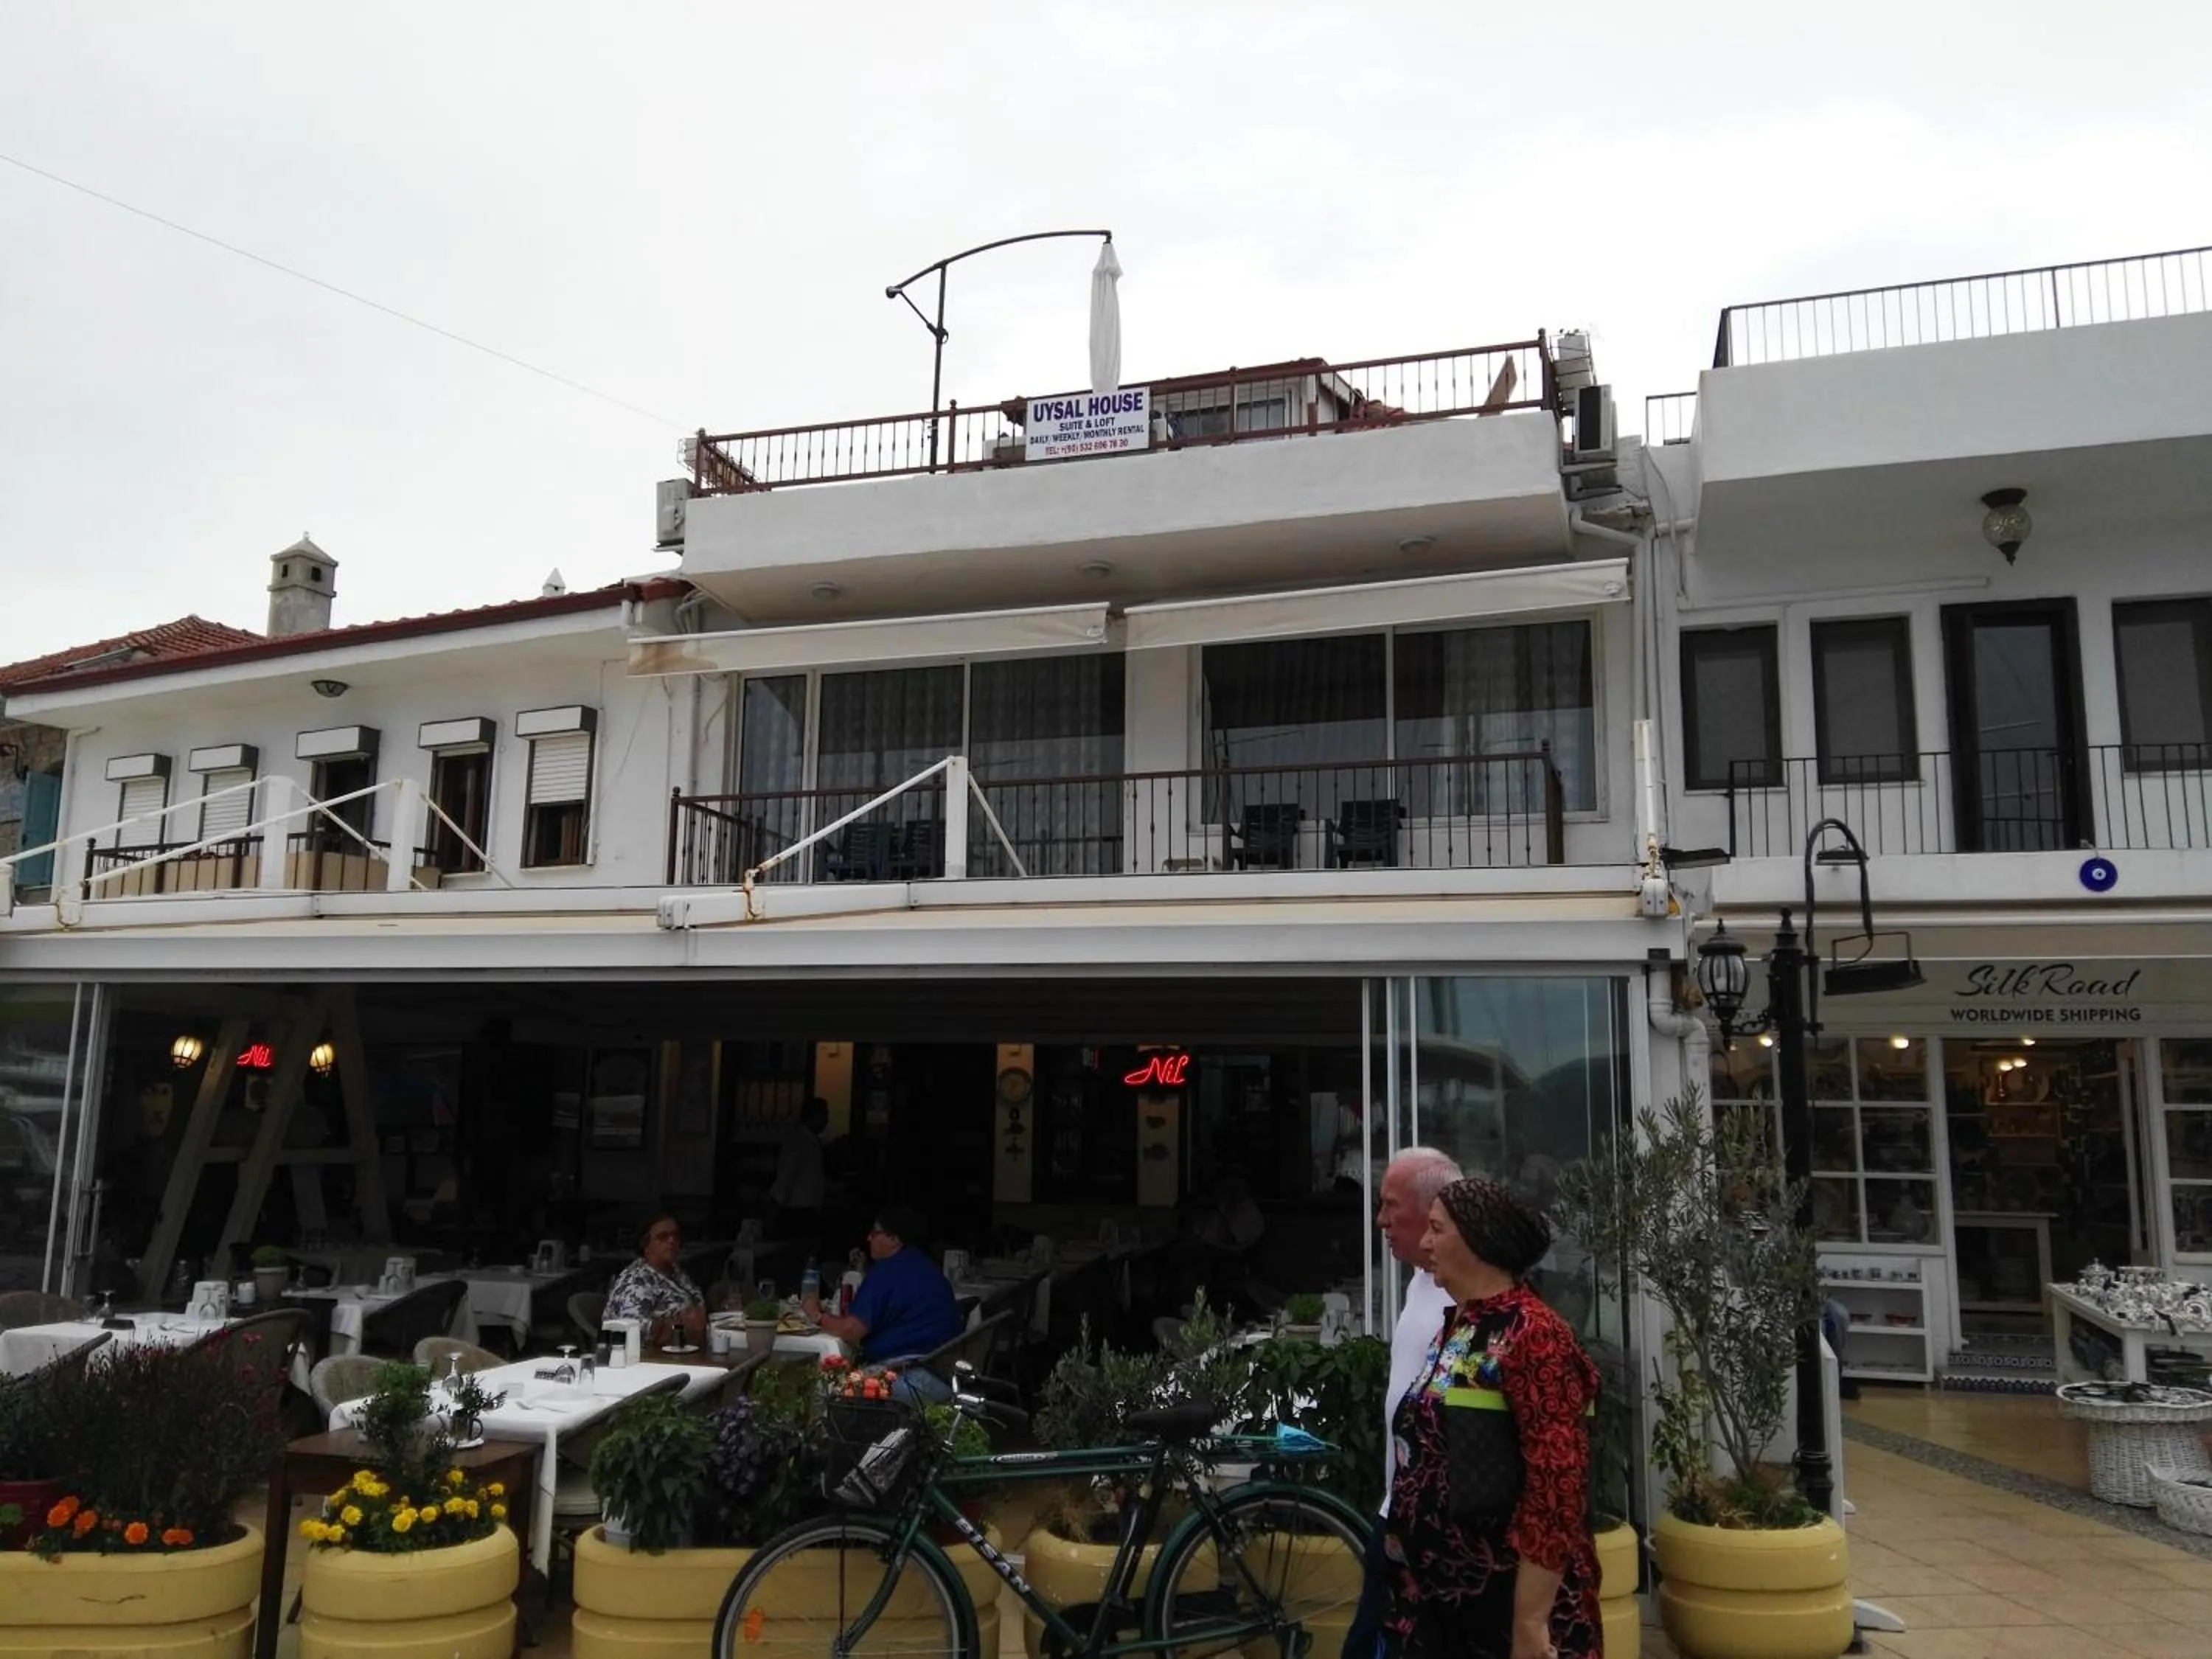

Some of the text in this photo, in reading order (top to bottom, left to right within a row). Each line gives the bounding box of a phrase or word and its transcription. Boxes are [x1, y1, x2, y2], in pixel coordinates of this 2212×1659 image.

[1034, 392, 1144, 422] UYSAL HOUSE
[1059, 417, 1116, 431] SUITE & LOFT
[1118, 425, 1144, 436] RENTAL
[1955, 963, 2141, 998] Silk Road
[1950, 1008, 2141, 1022] WORLDWIDE SHIPPING
[1124, 1055, 1189, 1084] Nil
